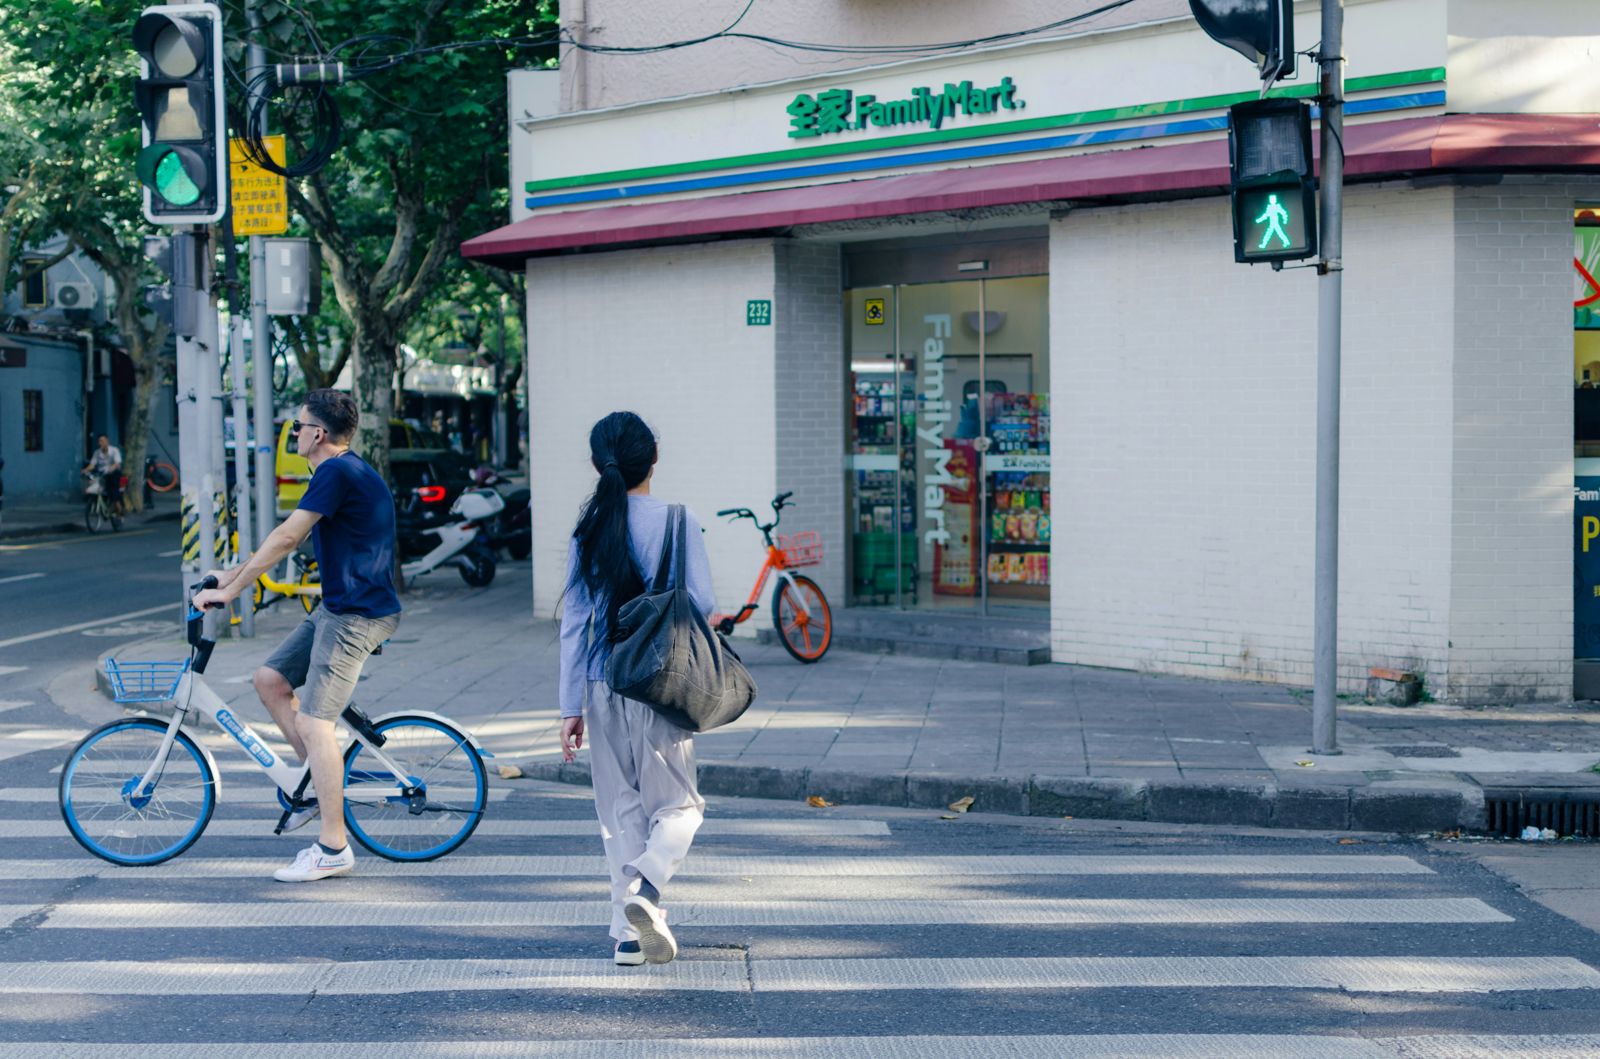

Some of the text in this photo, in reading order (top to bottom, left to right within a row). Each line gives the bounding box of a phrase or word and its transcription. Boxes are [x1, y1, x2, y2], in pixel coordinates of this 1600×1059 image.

[786, 76, 1018, 138] 全家 FamilyMart
[749, 302, 768, 317] 232
[917, 313, 953, 545] FamilyMart
